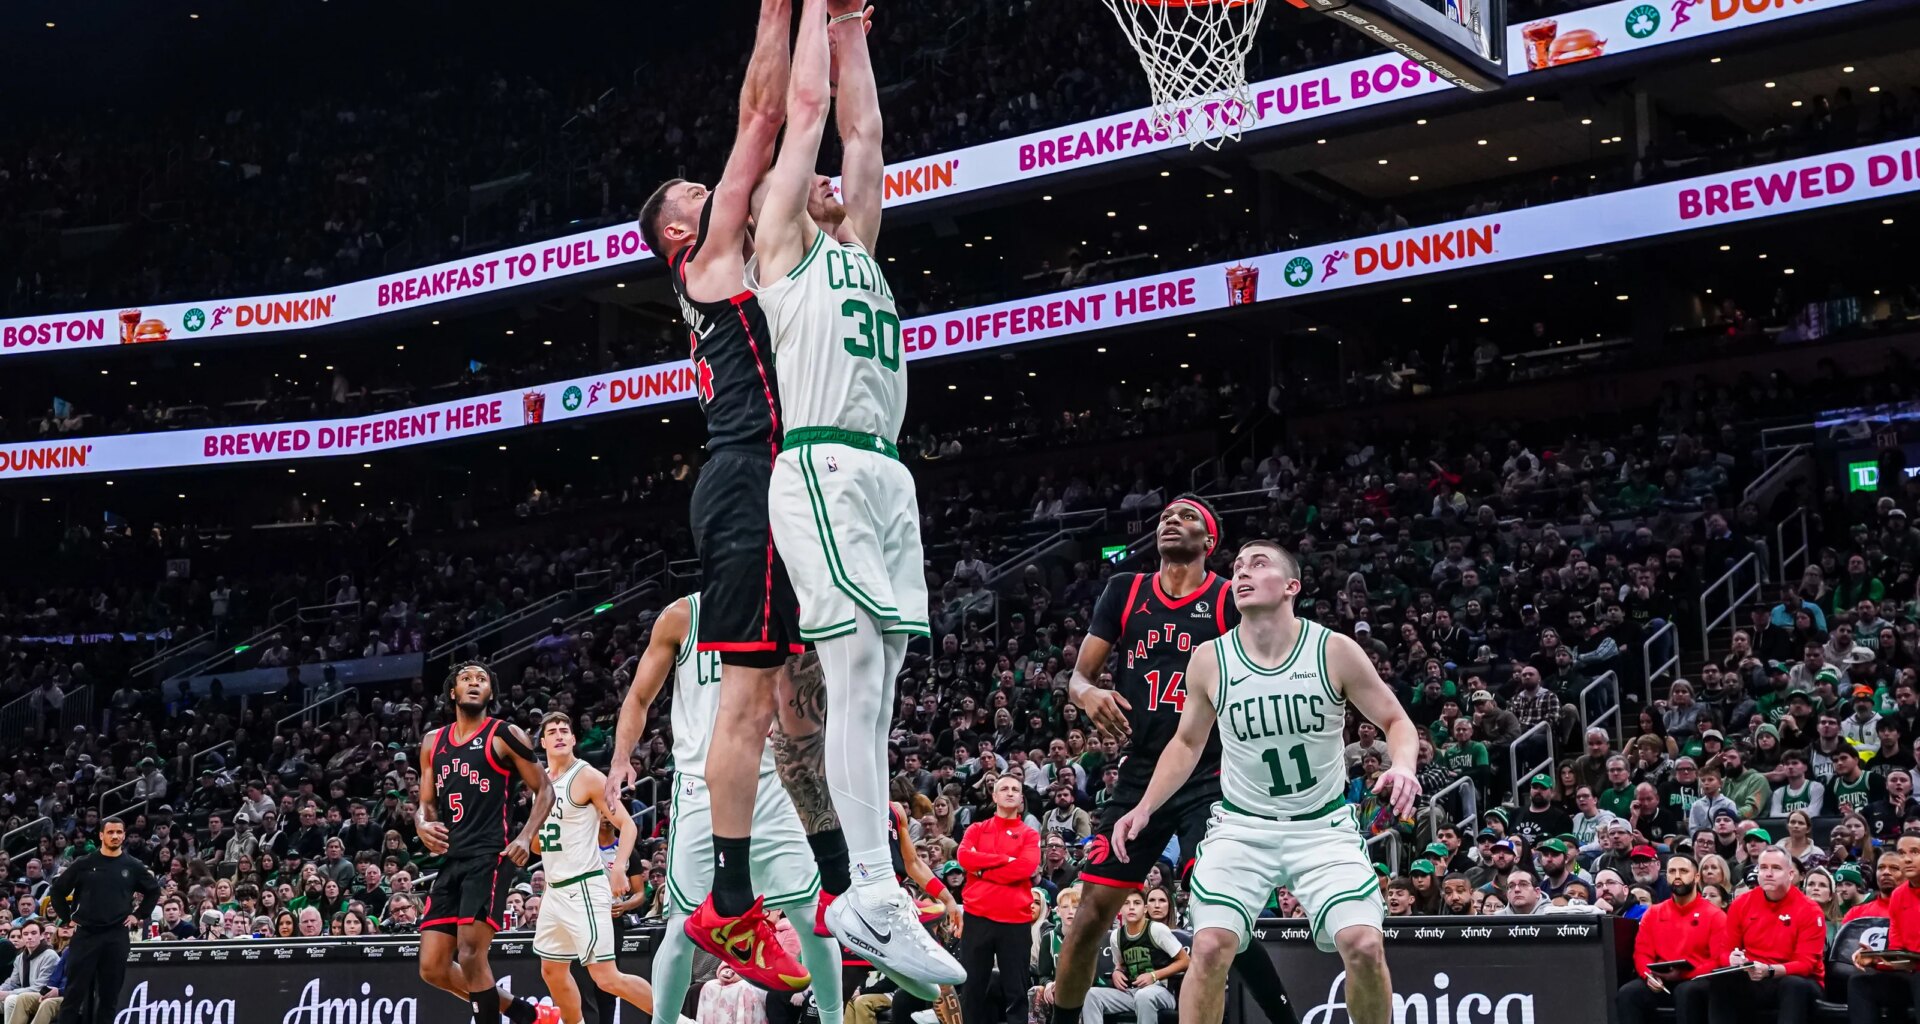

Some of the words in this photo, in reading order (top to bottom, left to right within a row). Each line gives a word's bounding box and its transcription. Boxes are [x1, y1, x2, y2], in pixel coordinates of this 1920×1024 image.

[1019, 107, 1193, 171] BREAKFAST
[1200, 98, 1245, 130] TO
[1256, 76, 1341, 119] FUEL
[1351, 60, 1438, 99] BOS
[884, 159, 959, 200] NKIN'
[1679, 162, 1855, 220] BREWED
[1354, 223, 1501, 276] DUNKIN'
[378, 260, 499, 307] BREAKFAST
[505, 252, 536, 280] TO
[543, 240, 600, 273] FUEL
[235, 294, 336, 327] DUNKIN'
[945, 293, 1106, 346] DIFFERENT
[1115, 277, 1196, 318] HERE
[3, 318, 104, 348] BOSTON
[842, 298, 901, 373] 30
[609, 365, 697, 403] DUNKIN
[204, 429, 310, 457] BREWED
[318, 411, 441, 449] DIFFERENT
[445, 400, 502, 432] HERE
[1127, 623, 1198, 669] RAPTO
[1144, 669, 1188, 713] 14
[1289, 671, 1317, 681] Amica
[1228, 693, 1325, 742] CELTICS
[1261, 743, 1318, 797] 11
[448, 792, 464, 823] 5
[1875, 820, 1884, 834] 9
[1281, 927, 1310, 940] xfinity
[1414, 927, 1445, 939] xfinity
[1461, 926, 1492, 938] xfinity
[1508, 925, 1540, 938] xfinity
[1556, 924, 1590, 937] xfinity
[113, 980, 236, 1024] Amica
[282, 977, 417, 1024] Amica
